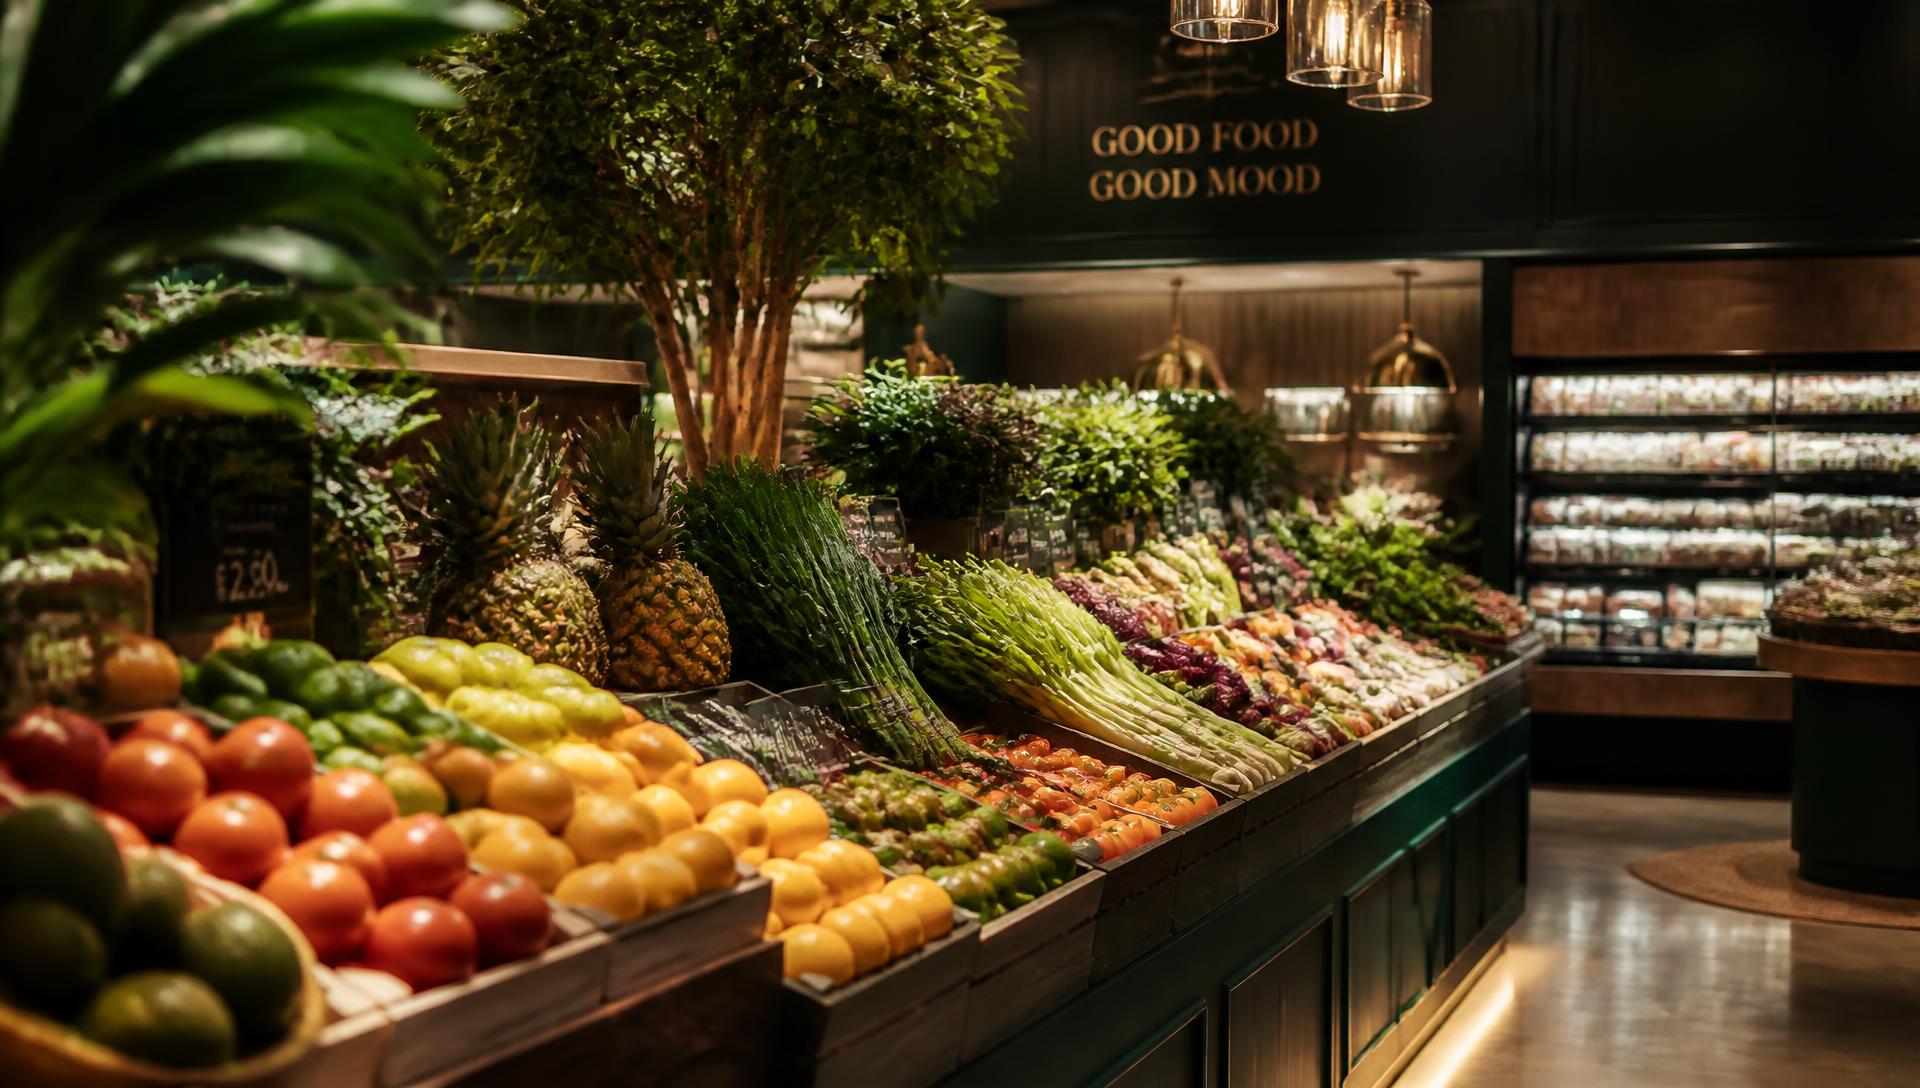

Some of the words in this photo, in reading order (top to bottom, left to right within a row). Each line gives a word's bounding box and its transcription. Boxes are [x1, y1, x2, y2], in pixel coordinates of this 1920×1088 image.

[1091, 123, 1199, 156] GOOD
[1212, 118, 1318, 152] FOOD
[1089, 168, 1196, 200] GOOD
[1208, 163, 1320, 196] MOOD
